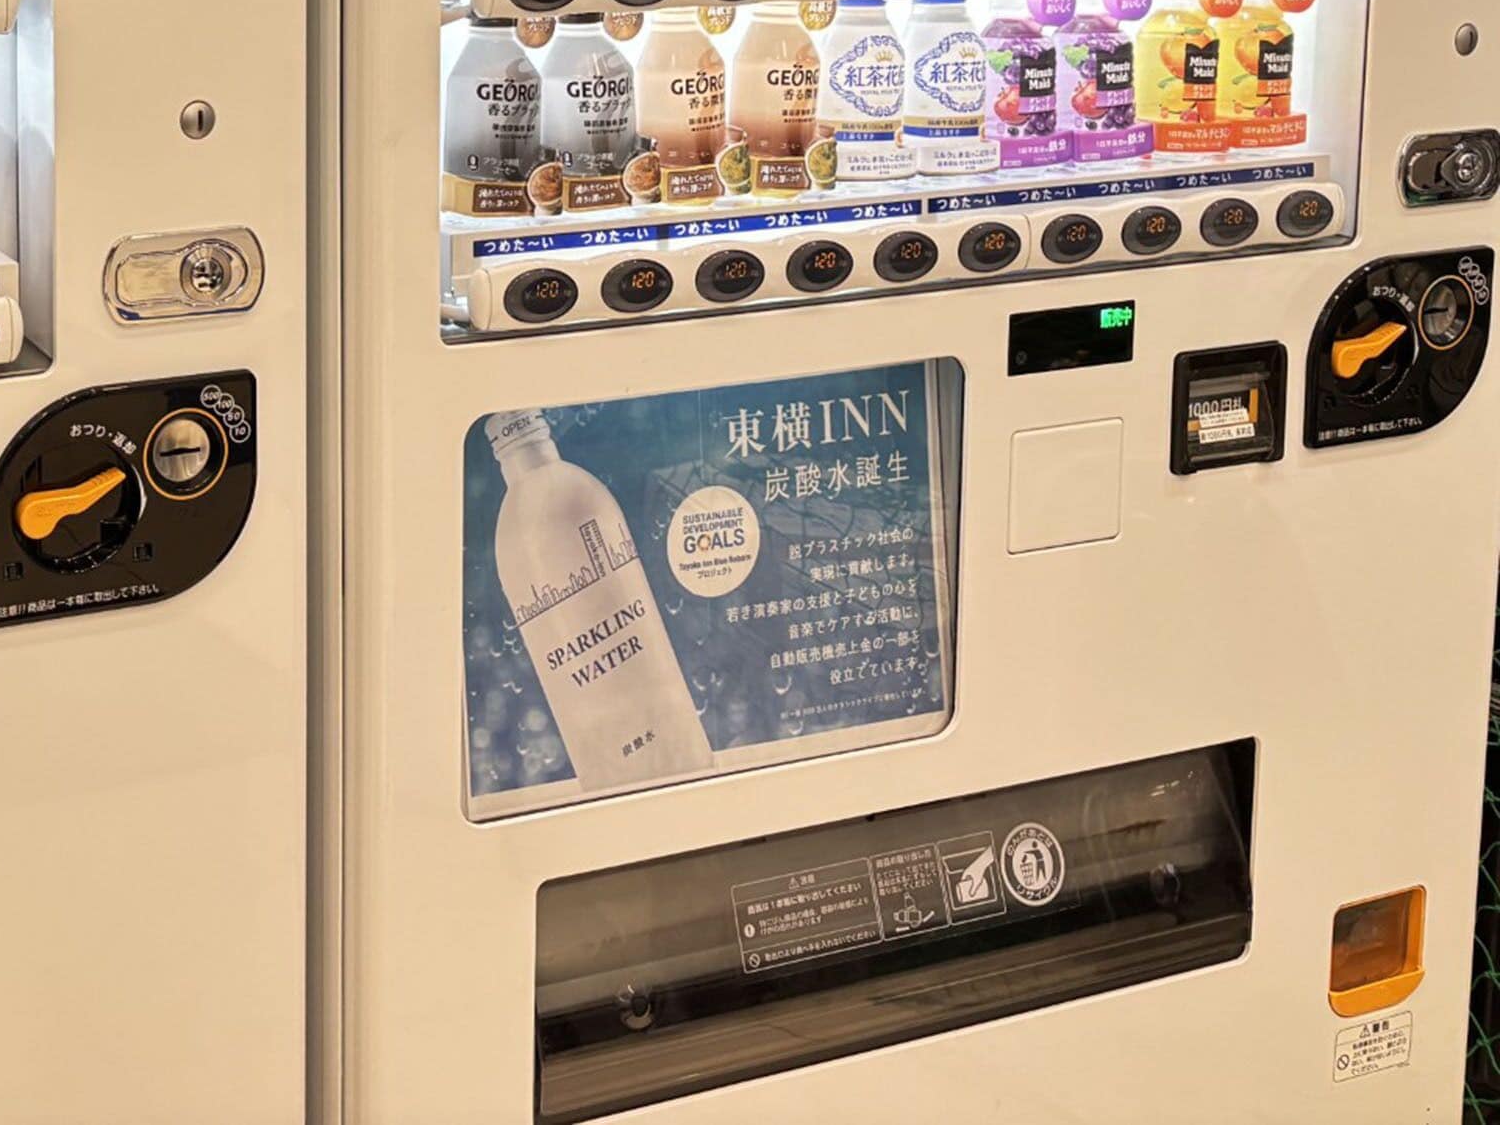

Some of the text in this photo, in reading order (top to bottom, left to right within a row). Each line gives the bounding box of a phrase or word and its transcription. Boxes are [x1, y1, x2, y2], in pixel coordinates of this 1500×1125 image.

[501, 416, 531, 439] OPEN
[723, 389, 911, 459] 東横INN
[763, 451, 911, 504] 炭酸水誕生
[684, 528, 745, 553] GOALS
[546, 599, 646, 671] SPARKLING
[570, 635, 644, 689] WATER
